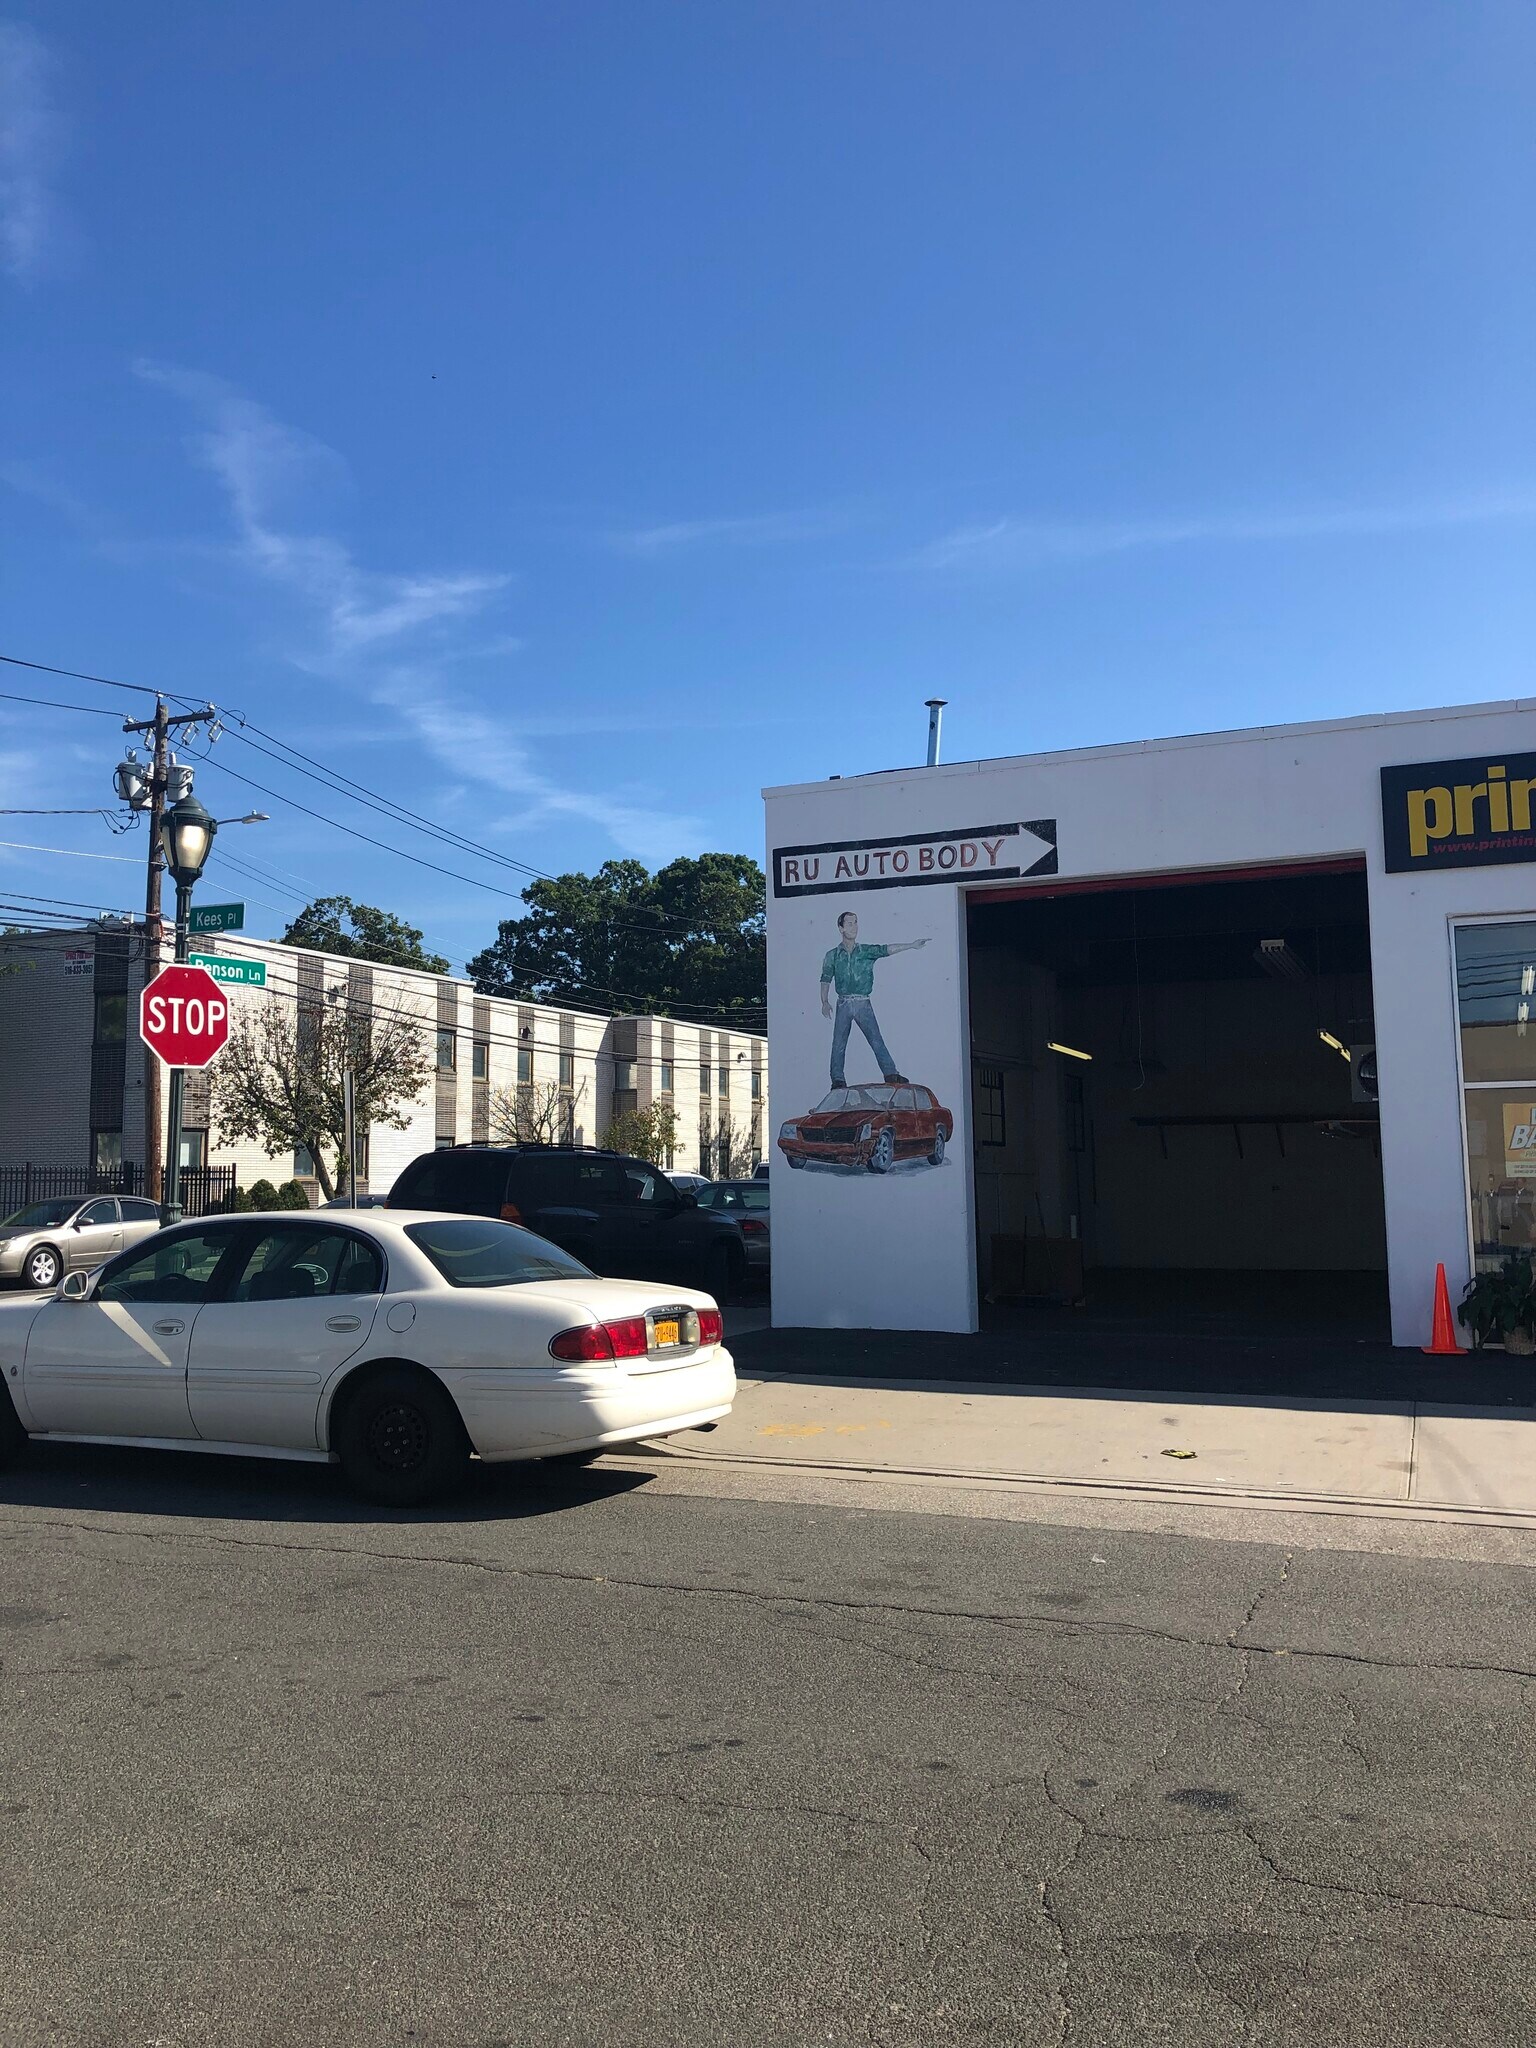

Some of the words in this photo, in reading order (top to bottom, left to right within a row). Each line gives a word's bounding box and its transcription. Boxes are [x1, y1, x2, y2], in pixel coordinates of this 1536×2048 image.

[1433, 836, 1536, 854] www.printin
[785, 858, 820, 884] RU
[834, 849, 910, 879] AUTO
[919, 839, 1006, 871] BODY
[196, 912, 222, 927] Kees
[248, 968, 261, 981] Ln
[147, 996, 226, 1036] STOP
